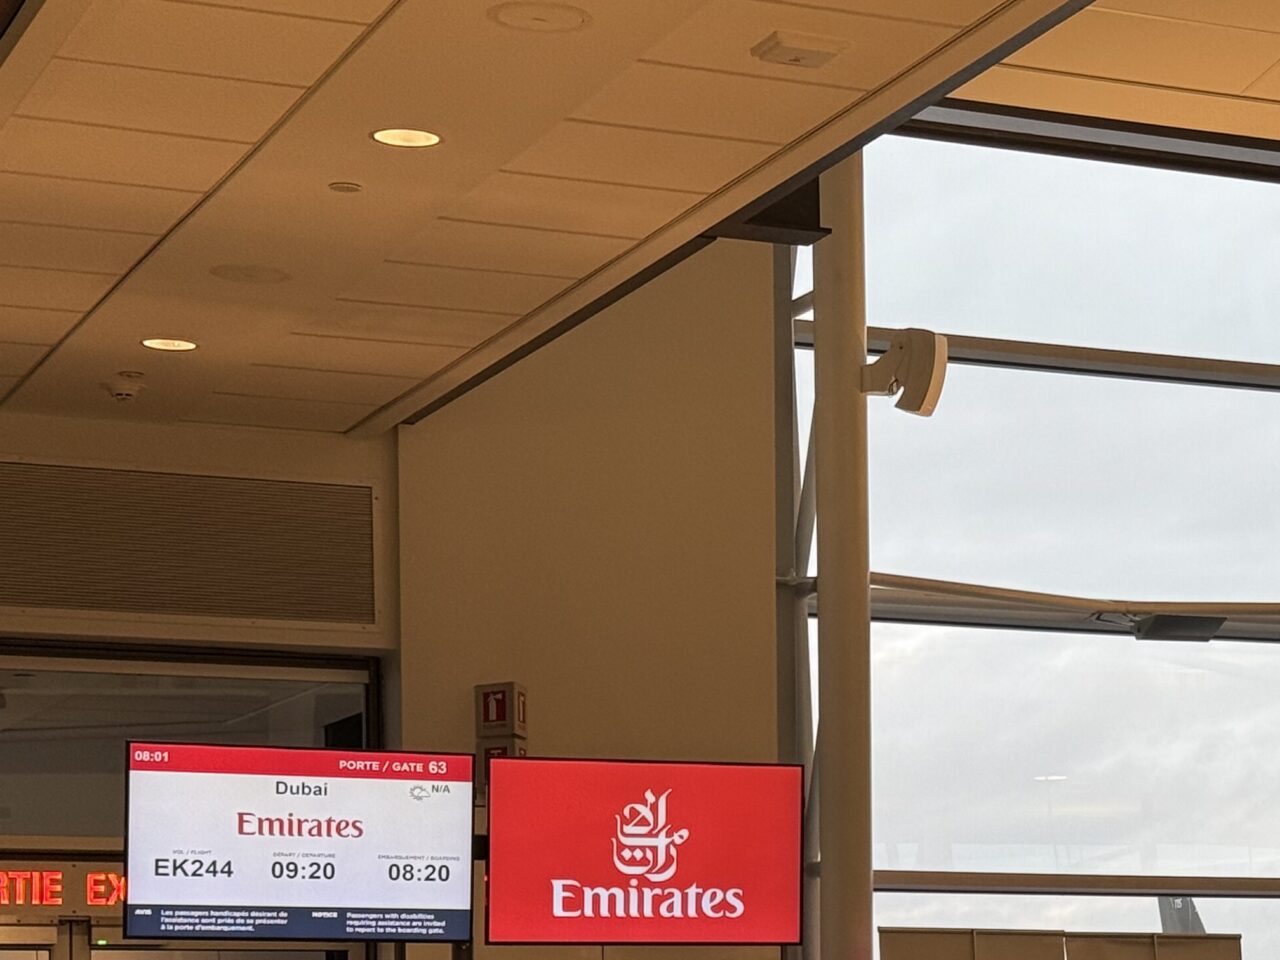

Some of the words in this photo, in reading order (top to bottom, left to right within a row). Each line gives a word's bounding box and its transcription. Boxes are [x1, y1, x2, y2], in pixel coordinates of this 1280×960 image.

[134, 751, 169, 762] 08:01
[339, 760, 380, 771] PORTE
[392, 762, 424, 772] GATE
[428, 761, 447, 774] 63
[276, 781, 328, 796] Dubai
[431, 784, 450, 794] N/A
[237, 812, 364, 838] Emirates
[154, 858, 234, 878] EK244
[271, 861, 335, 880] 09:20
[388, 863, 450, 882] 08:20
[551, 879, 745, 919] Emirates
